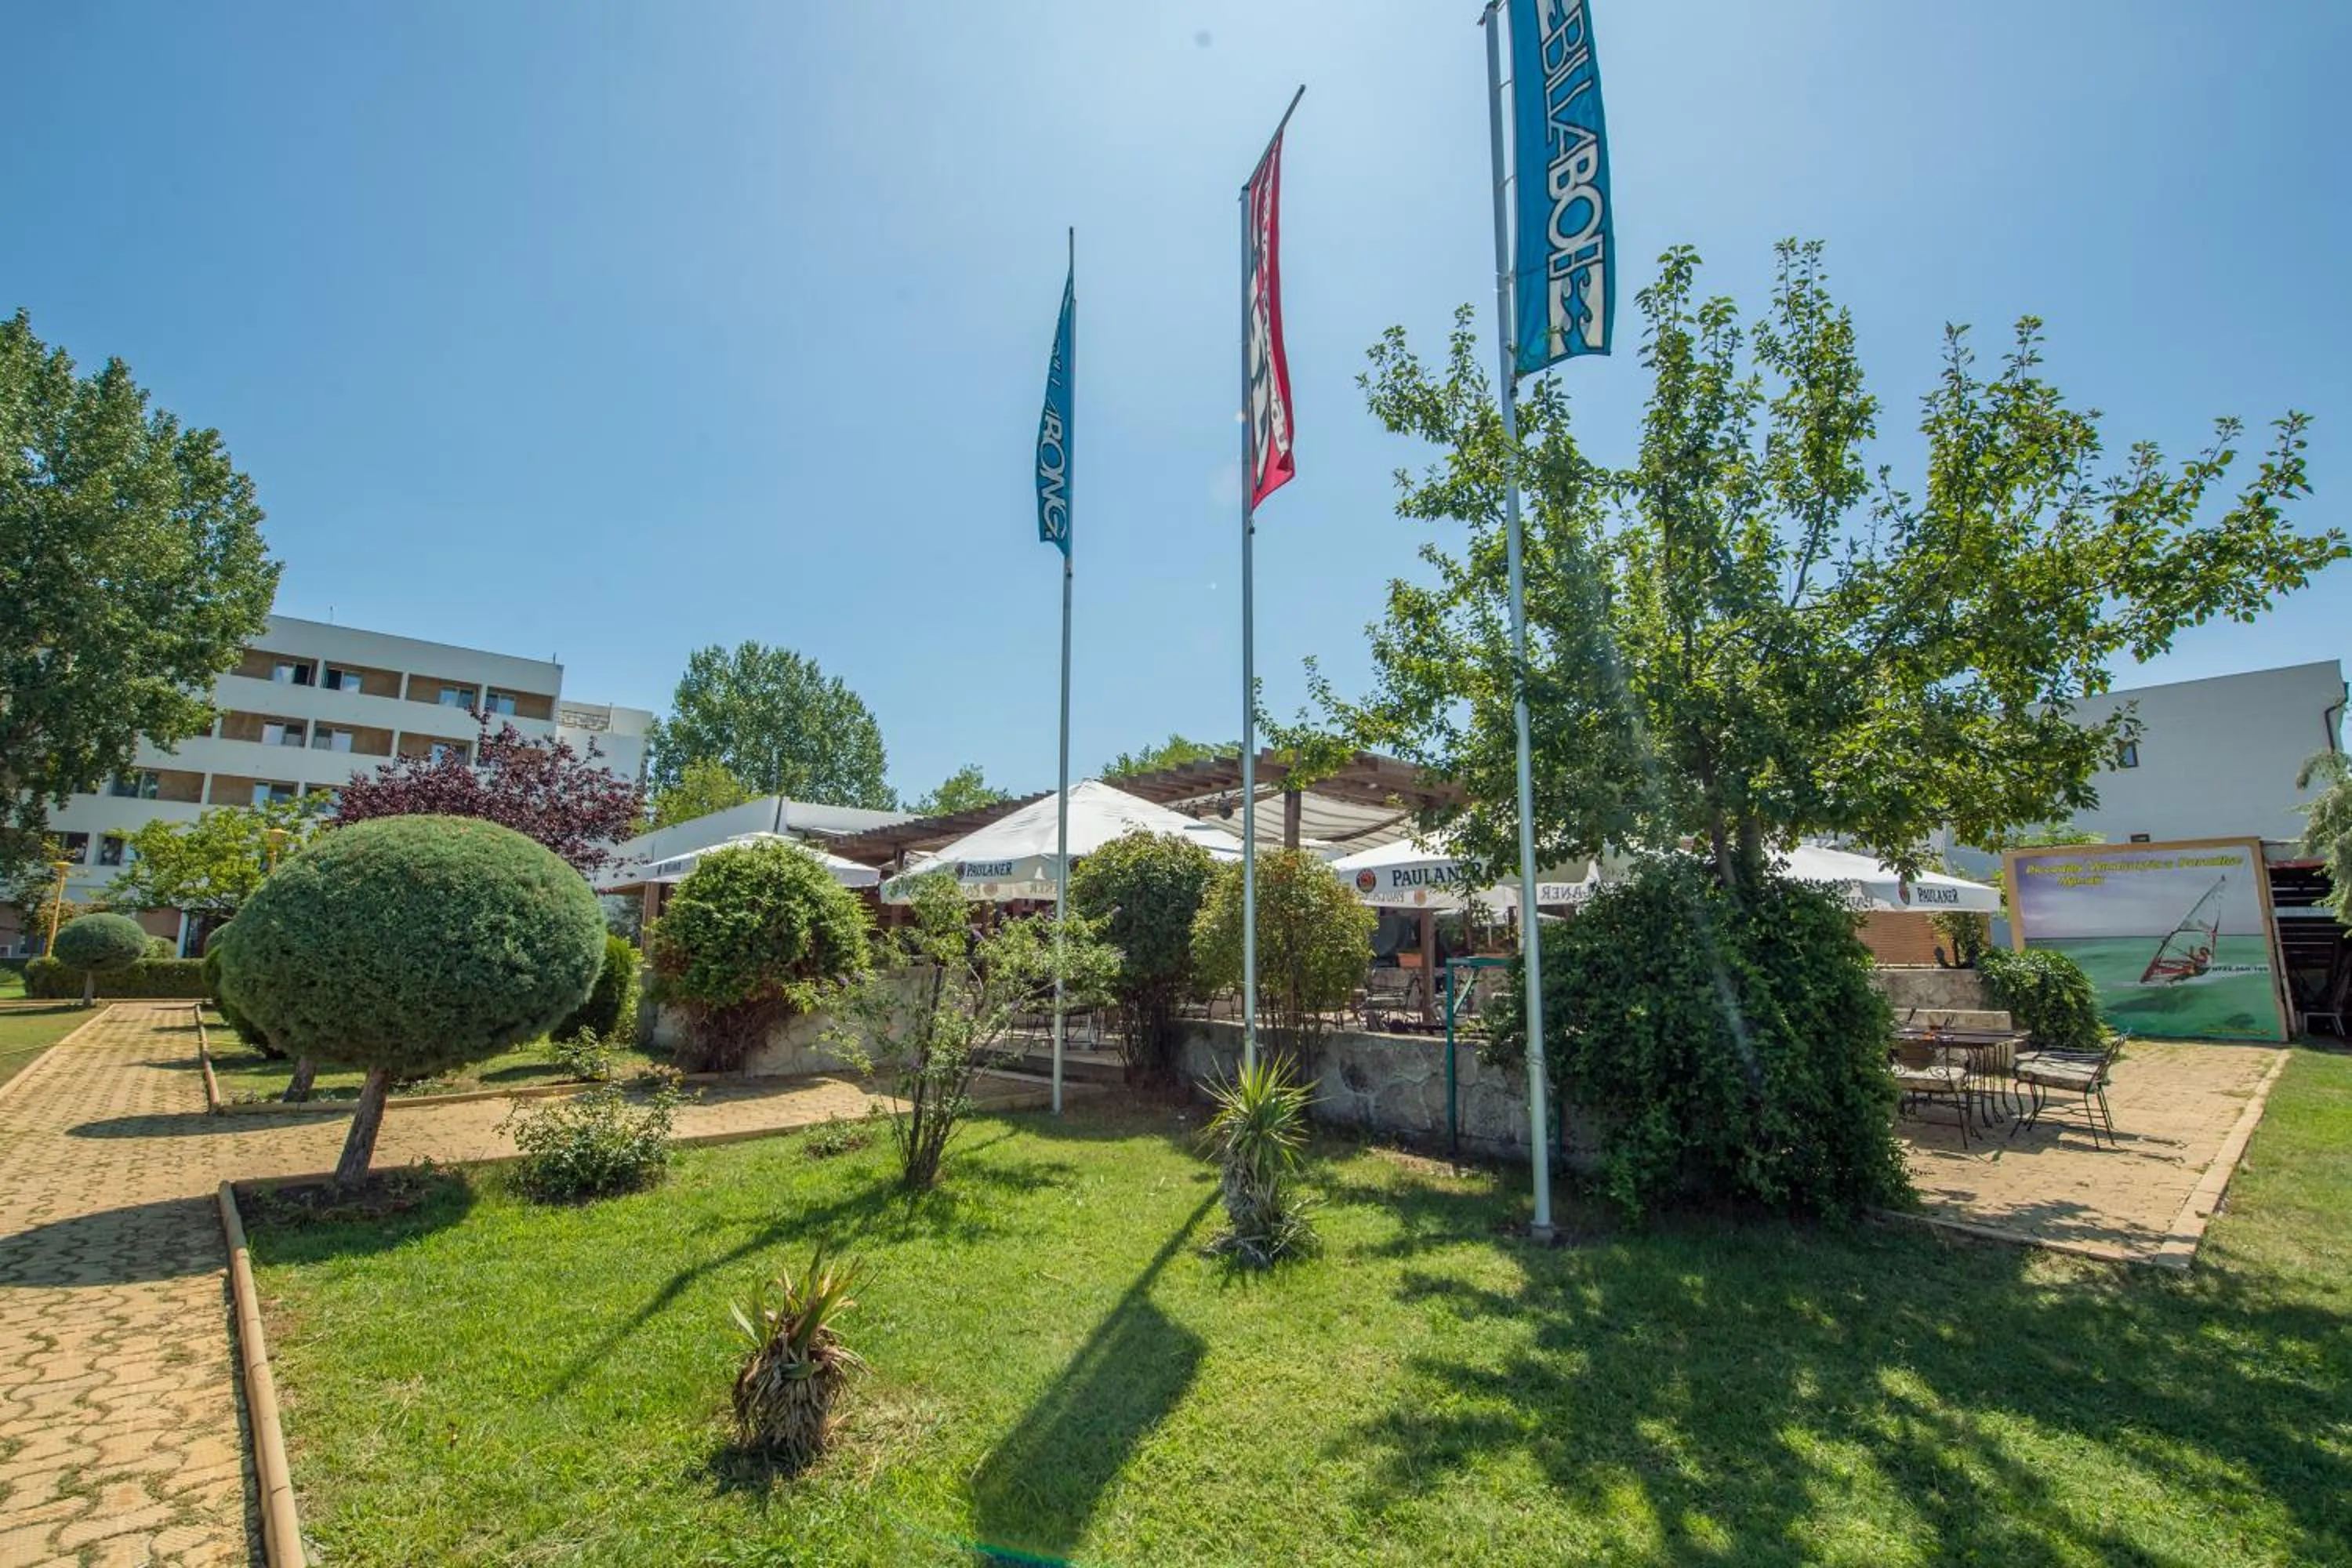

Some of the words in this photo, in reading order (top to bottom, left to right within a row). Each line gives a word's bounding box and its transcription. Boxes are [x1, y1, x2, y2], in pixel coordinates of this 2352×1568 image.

[1541, 3, 1605, 279] BILLABO
[967, 862, 1012, 877] PAULANER
[1392, 862, 1485, 887] PAULANR
[1917, 887, 1958, 904] PAULANER
